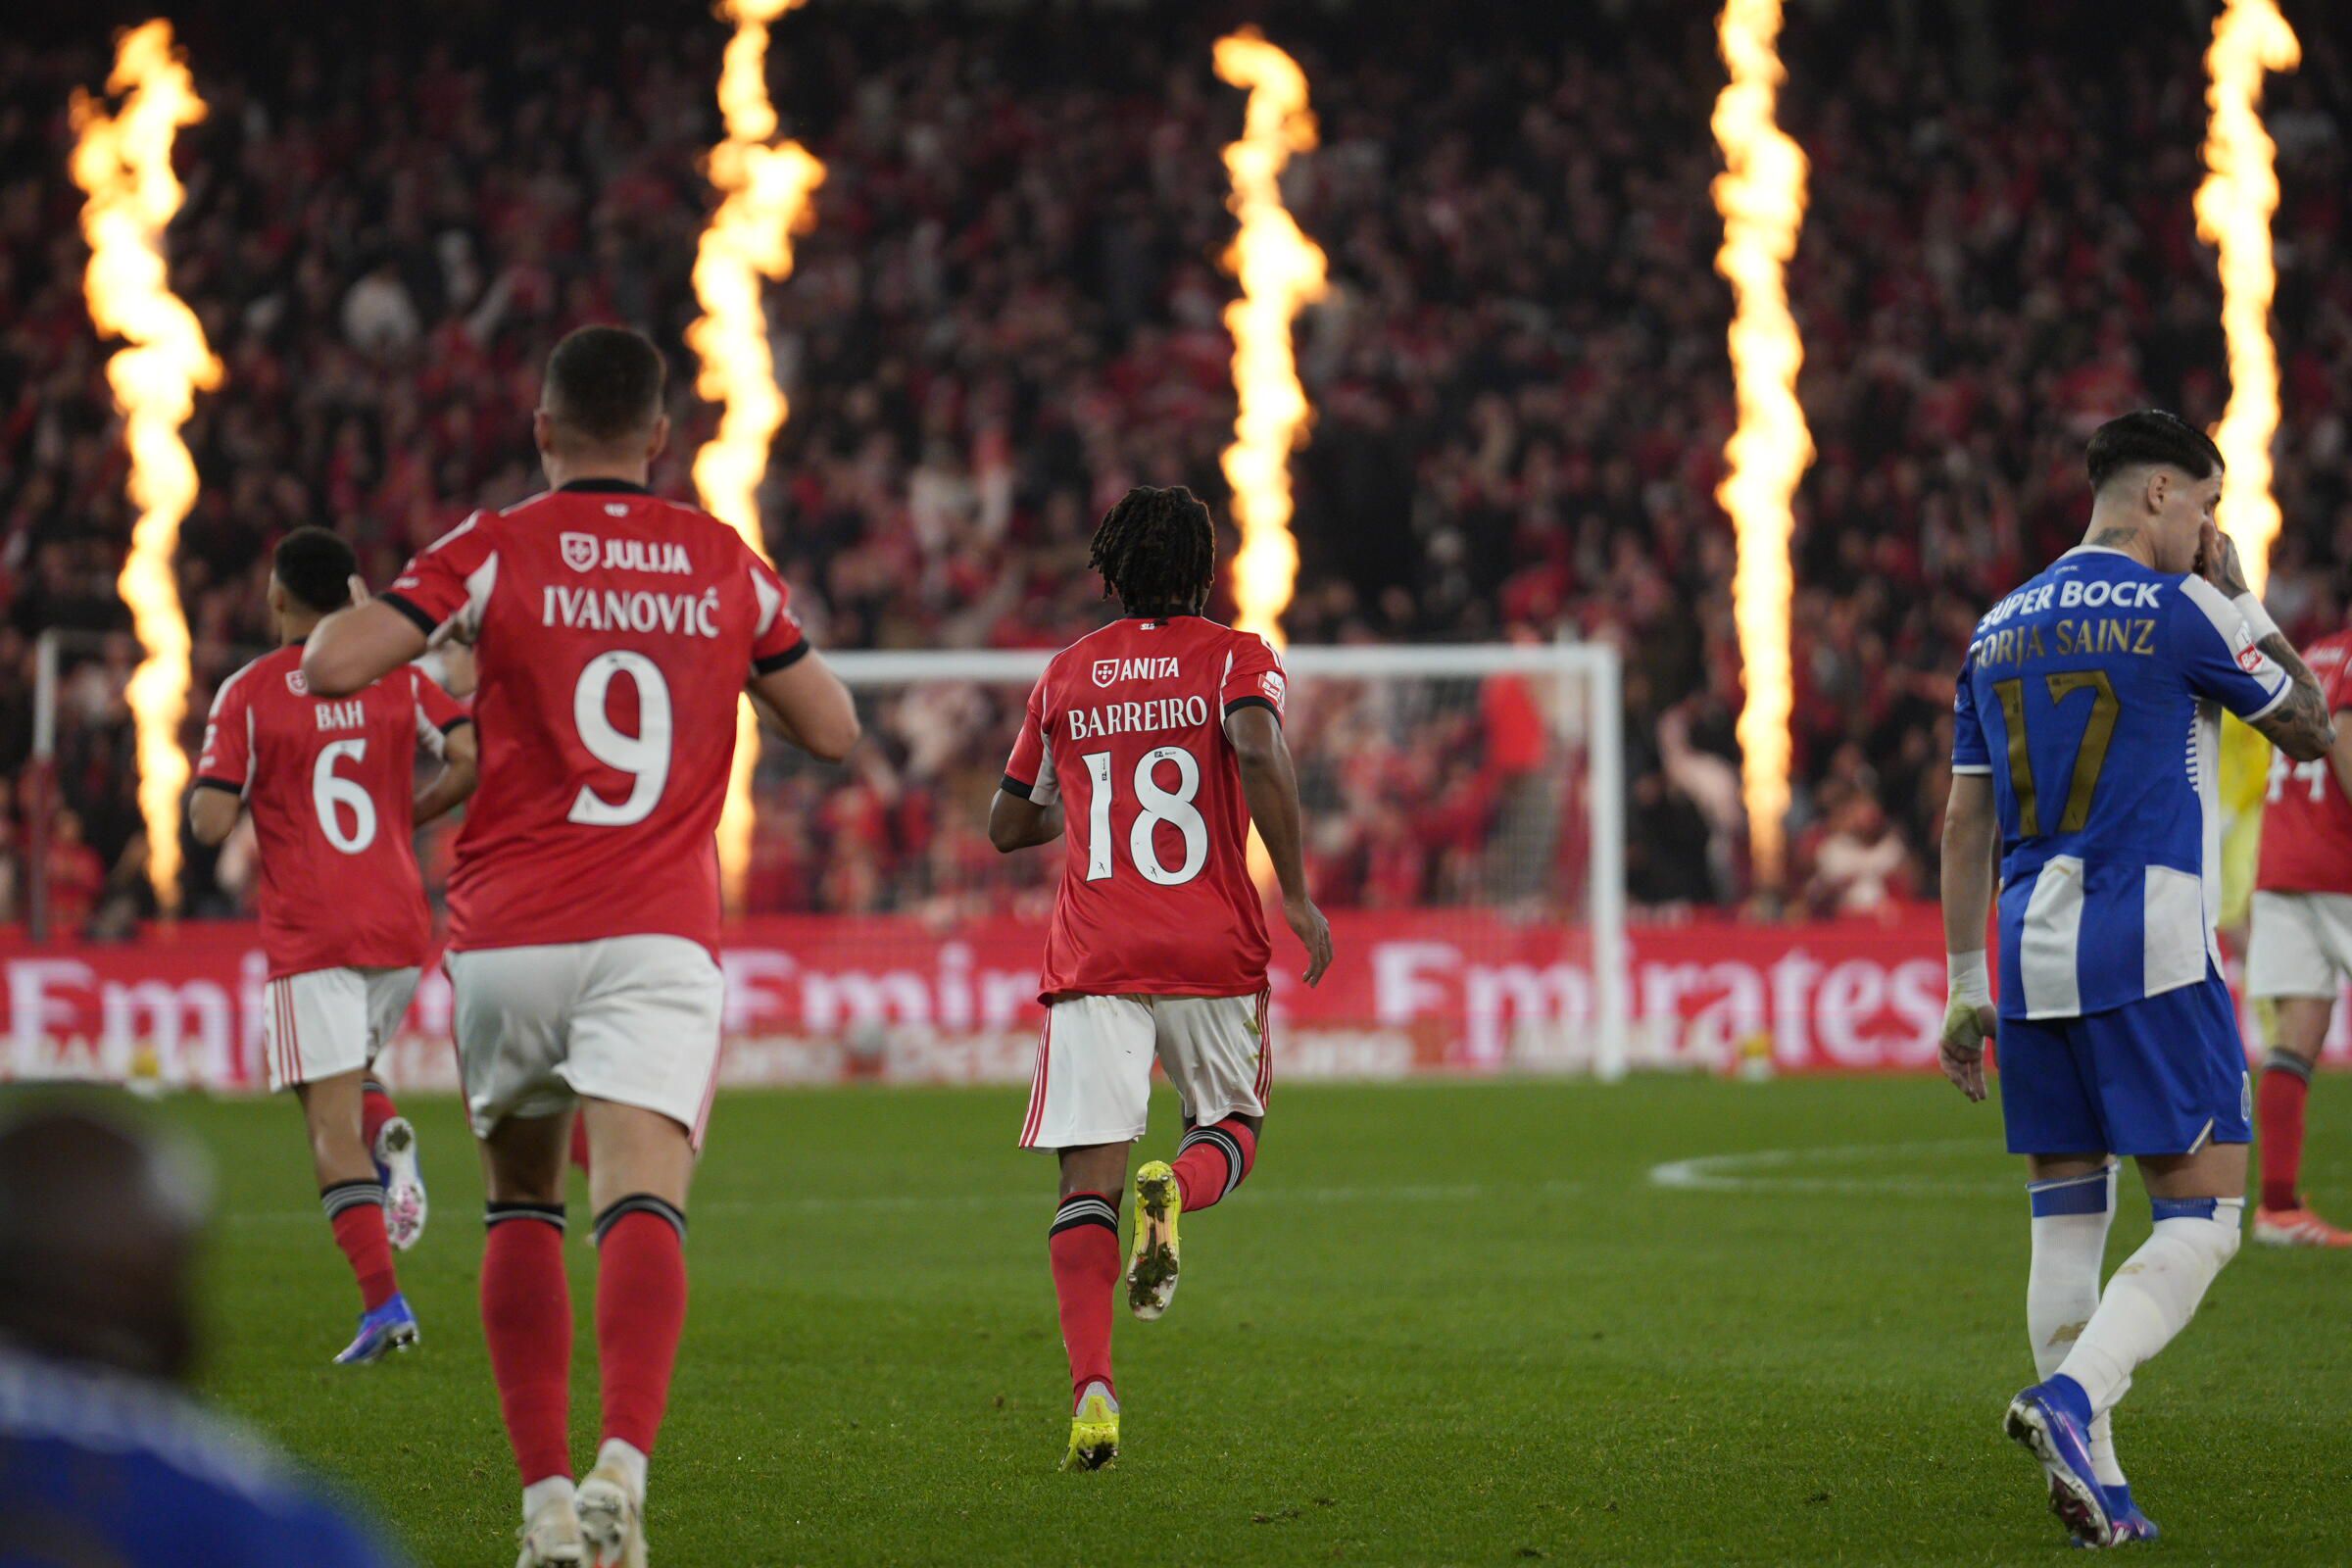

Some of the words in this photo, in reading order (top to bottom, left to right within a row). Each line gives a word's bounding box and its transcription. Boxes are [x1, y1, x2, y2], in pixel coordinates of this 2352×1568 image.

[603, 539, 692, 574] JULIJA
[542, 586, 719, 638] IVANOVIĆ
[1977, 583, 2055, 633] SUPER
[2059, 580, 2163, 609] BOCK
[2056, 618, 2155, 655] SAINZ
[1120, 658, 1179, 681] ANITA
[316, 700, 366, 731] BAH
[566, 650, 673, 826] 9
[1067, 695, 1207, 741] BARREIRO
[1991, 669, 2121, 838] 17
[313, 739, 376, 855] 6
[1082, 746, 1208, 885] 18
